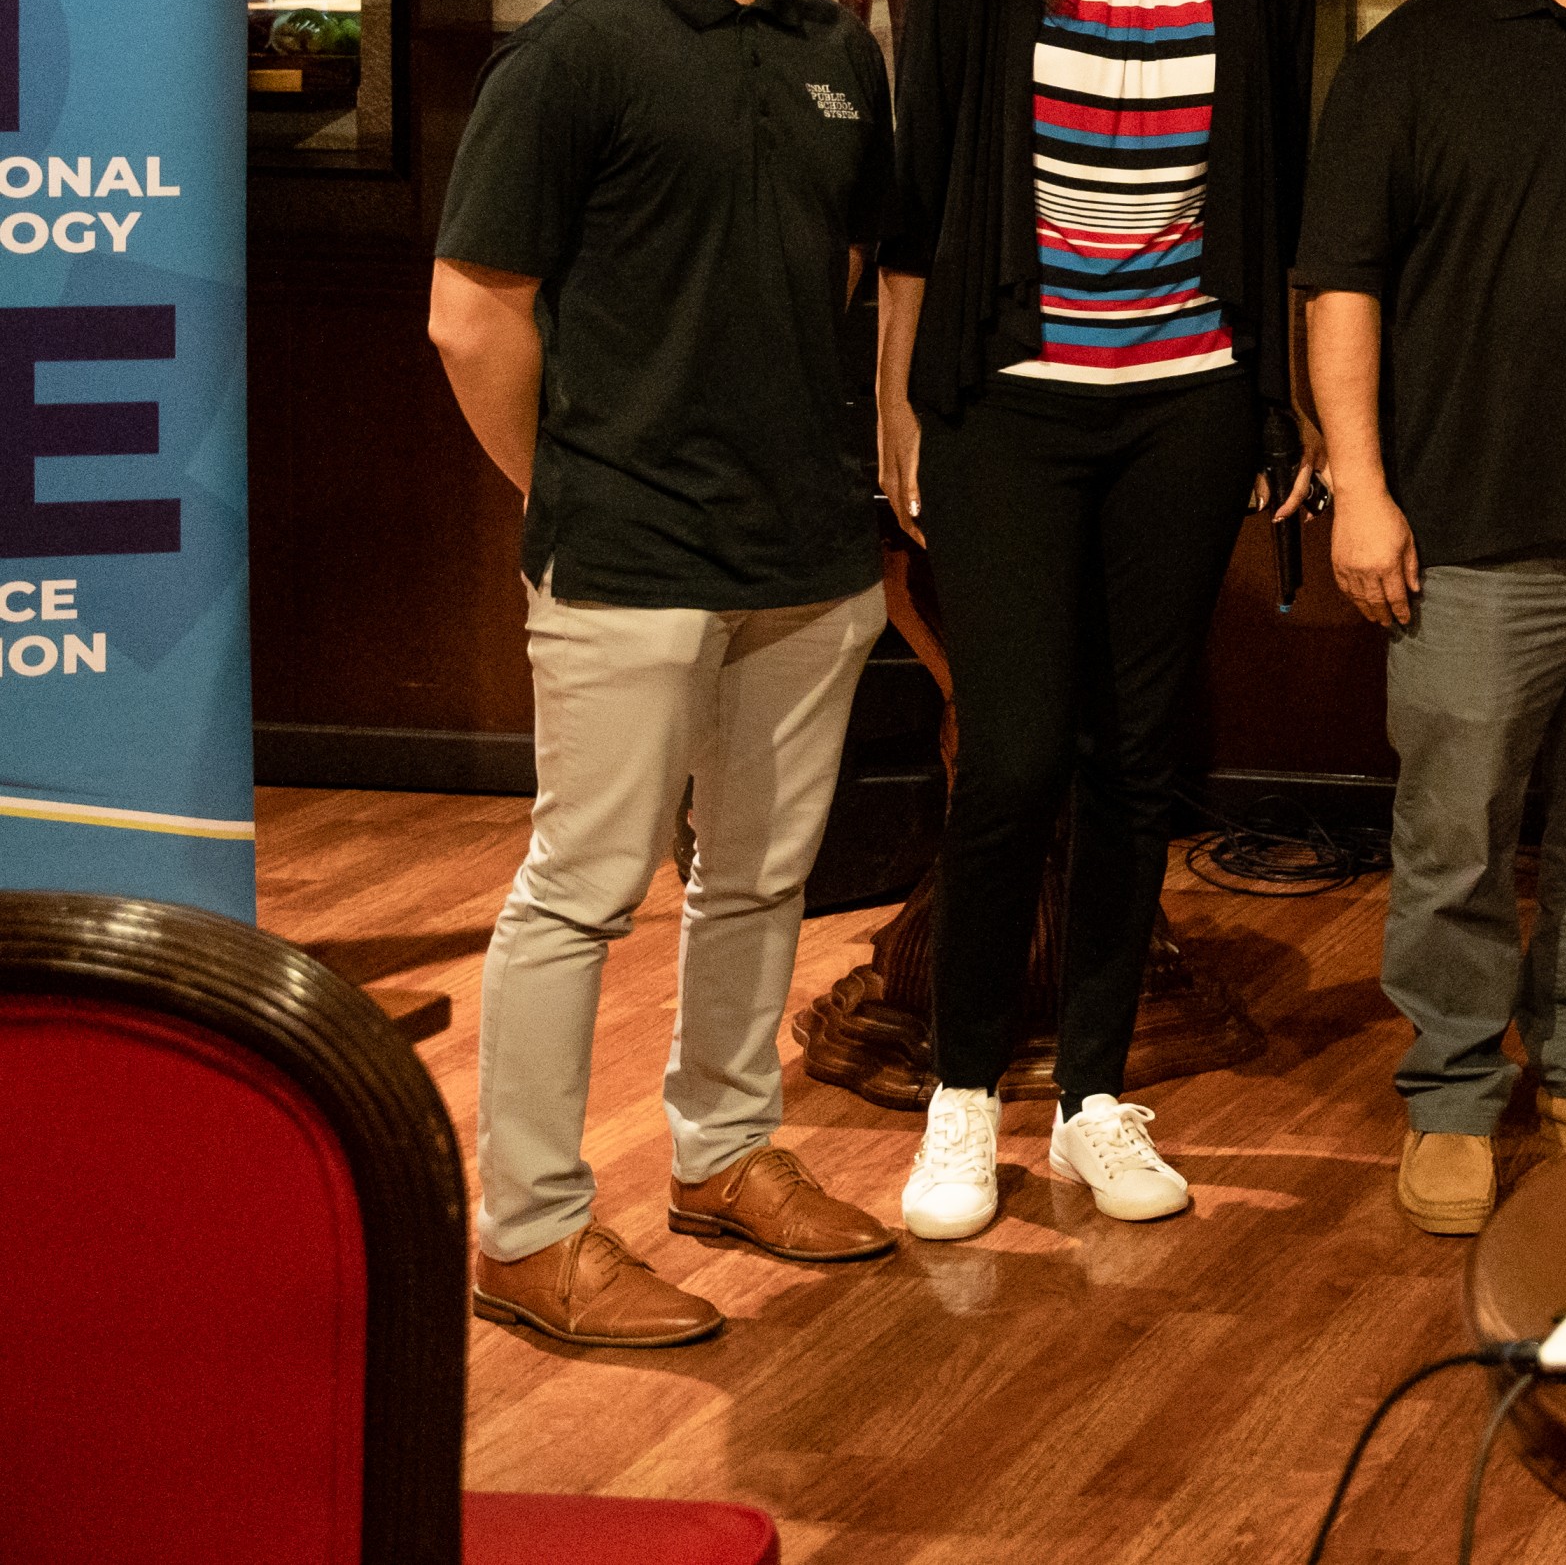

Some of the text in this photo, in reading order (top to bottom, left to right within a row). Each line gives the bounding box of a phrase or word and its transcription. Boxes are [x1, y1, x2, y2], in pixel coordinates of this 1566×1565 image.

[805, 82, 831, 93] CNMI
[811, 92, 846, 102] PUBLIC
[817, 101, 854, 111] SCHOOL
[823, 110, 860, 120] SYSTEM
[0, 211, 142, 254] OGY
[0, 633, 107, 677] ON
